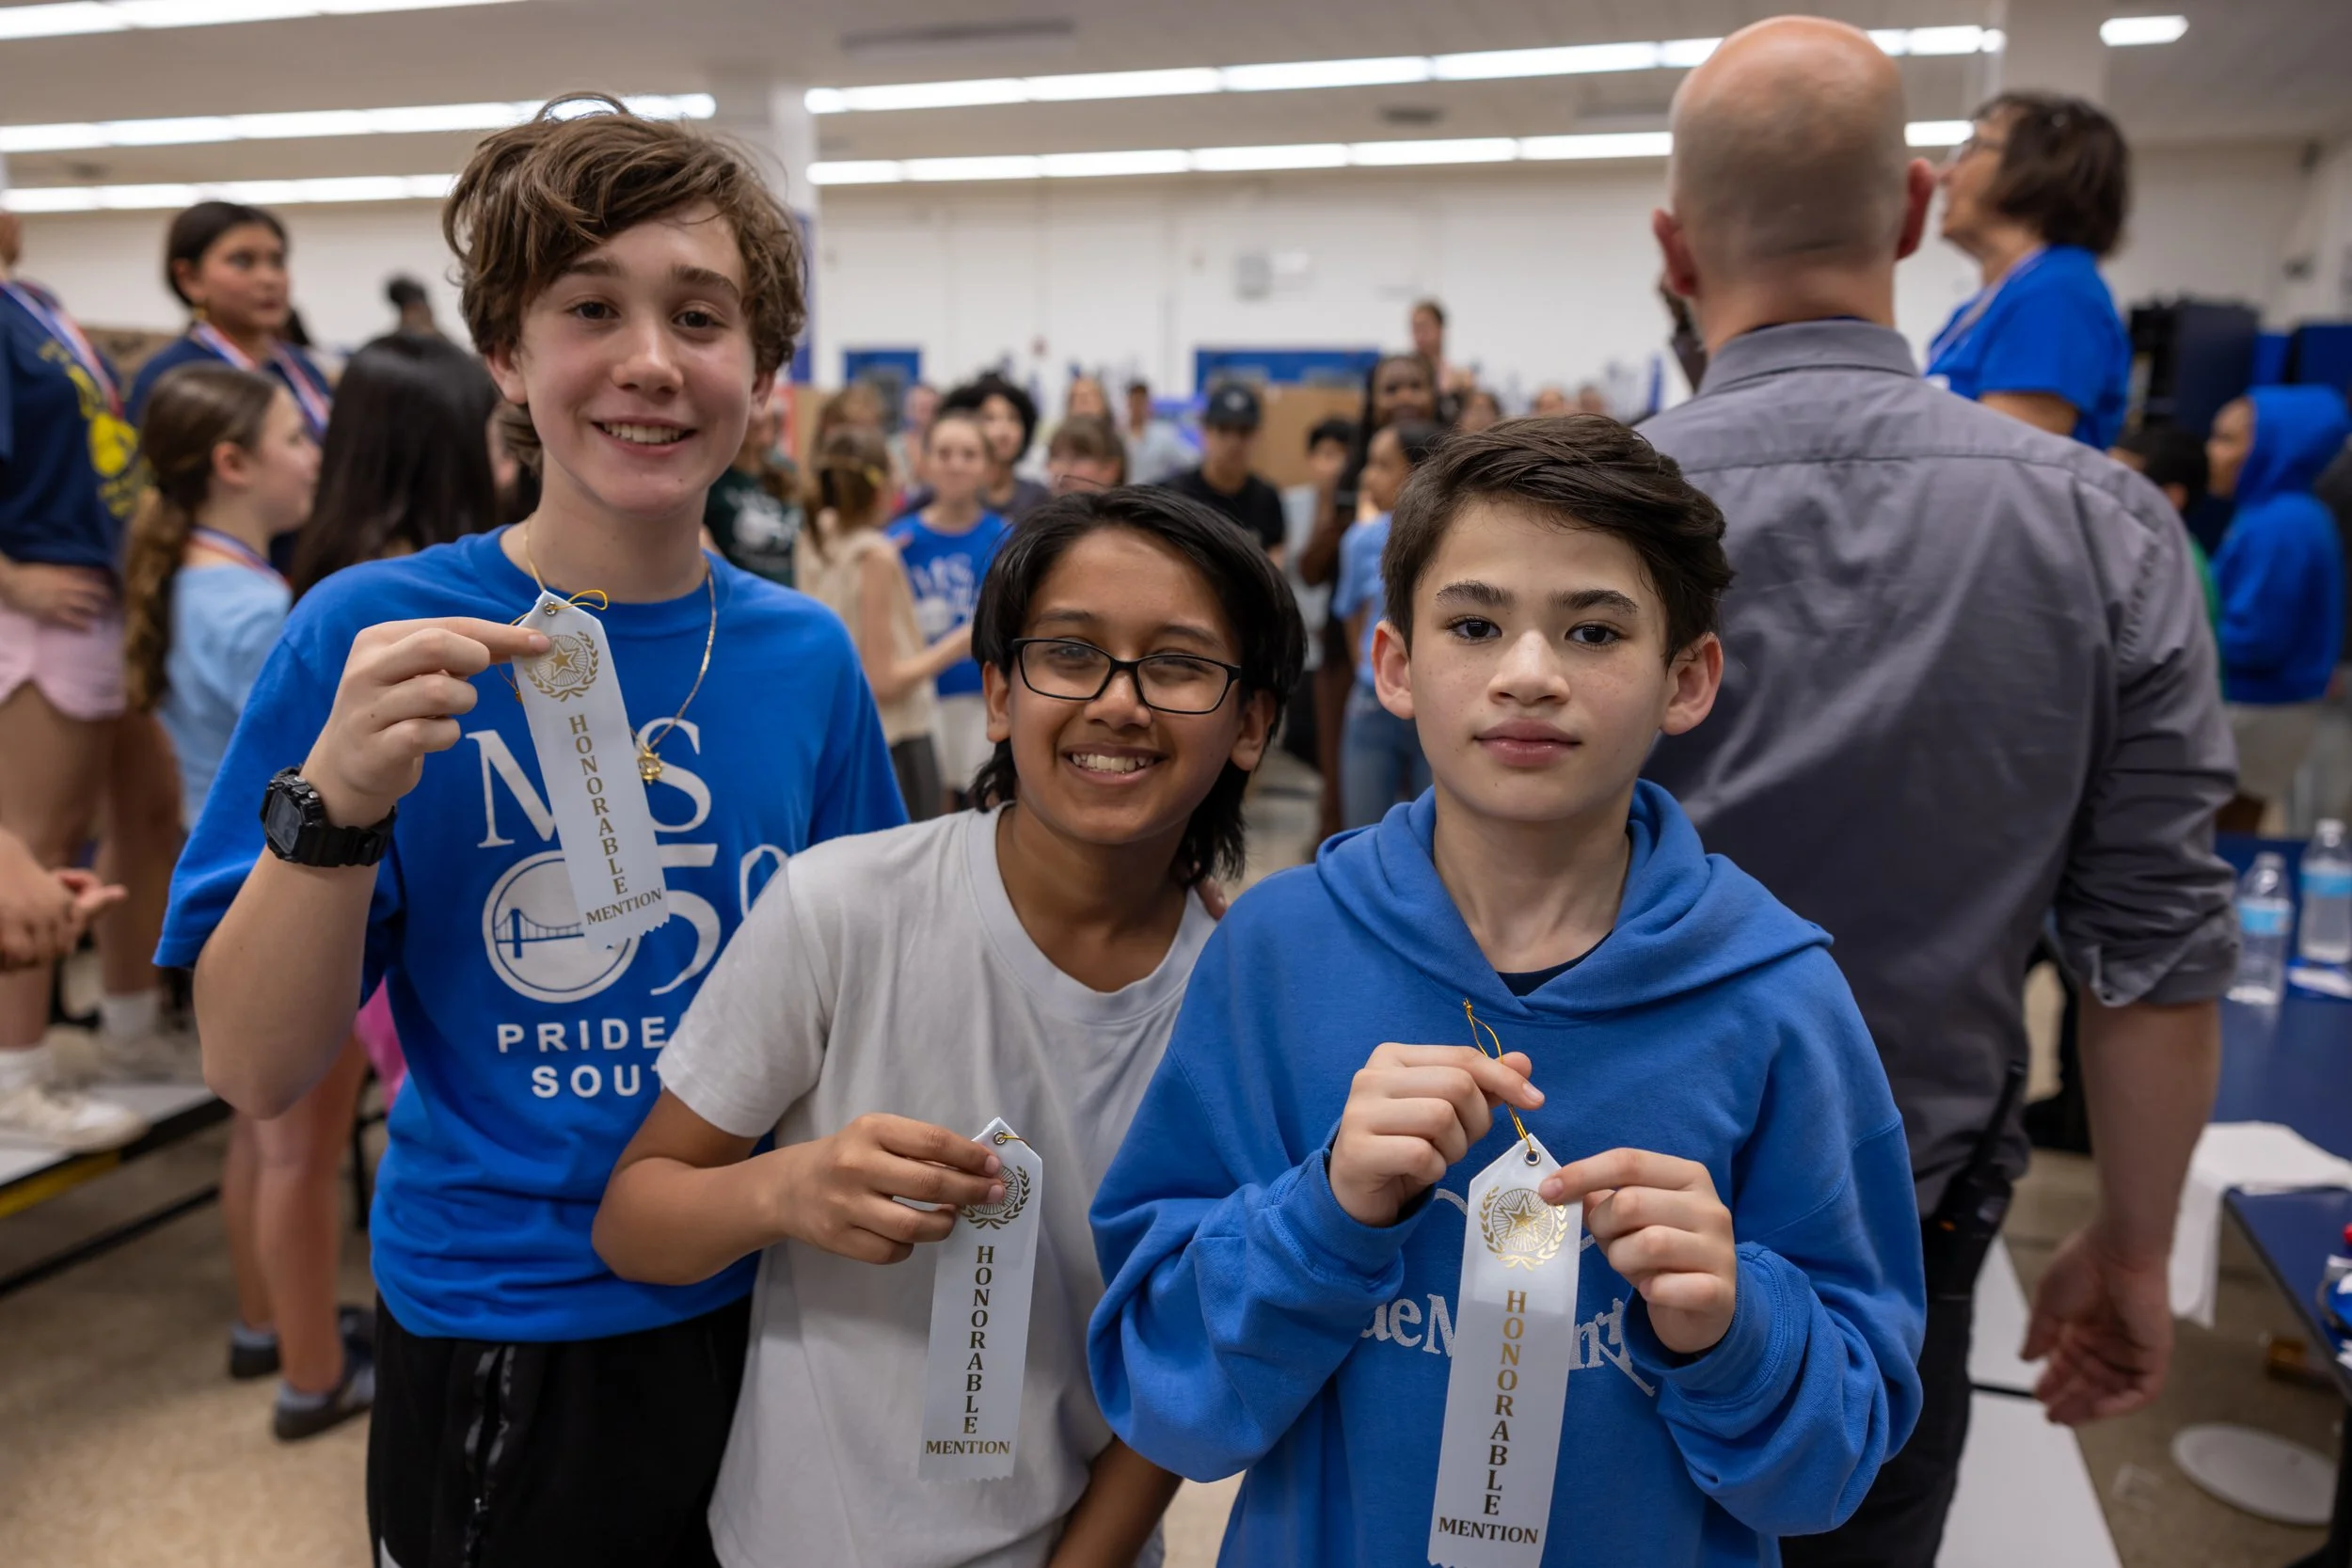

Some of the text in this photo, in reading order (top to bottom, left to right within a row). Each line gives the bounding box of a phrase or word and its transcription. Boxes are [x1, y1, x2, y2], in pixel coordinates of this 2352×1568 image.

[568, 713, 628, 895] HONORABLE
[585, 888, 663, 927] MENTION
[497, 1016, 667, 1053] PRIDE
[532, 1064, 659, 1099] SOU
[962, 1244, 994, 1435] HONORABLE
[1483, 1289, 1527, 1517] HONORABLE
[925, 1440, 1011, 1455] MENTION
[1437, 1516, 1540, 1545] MENTION
